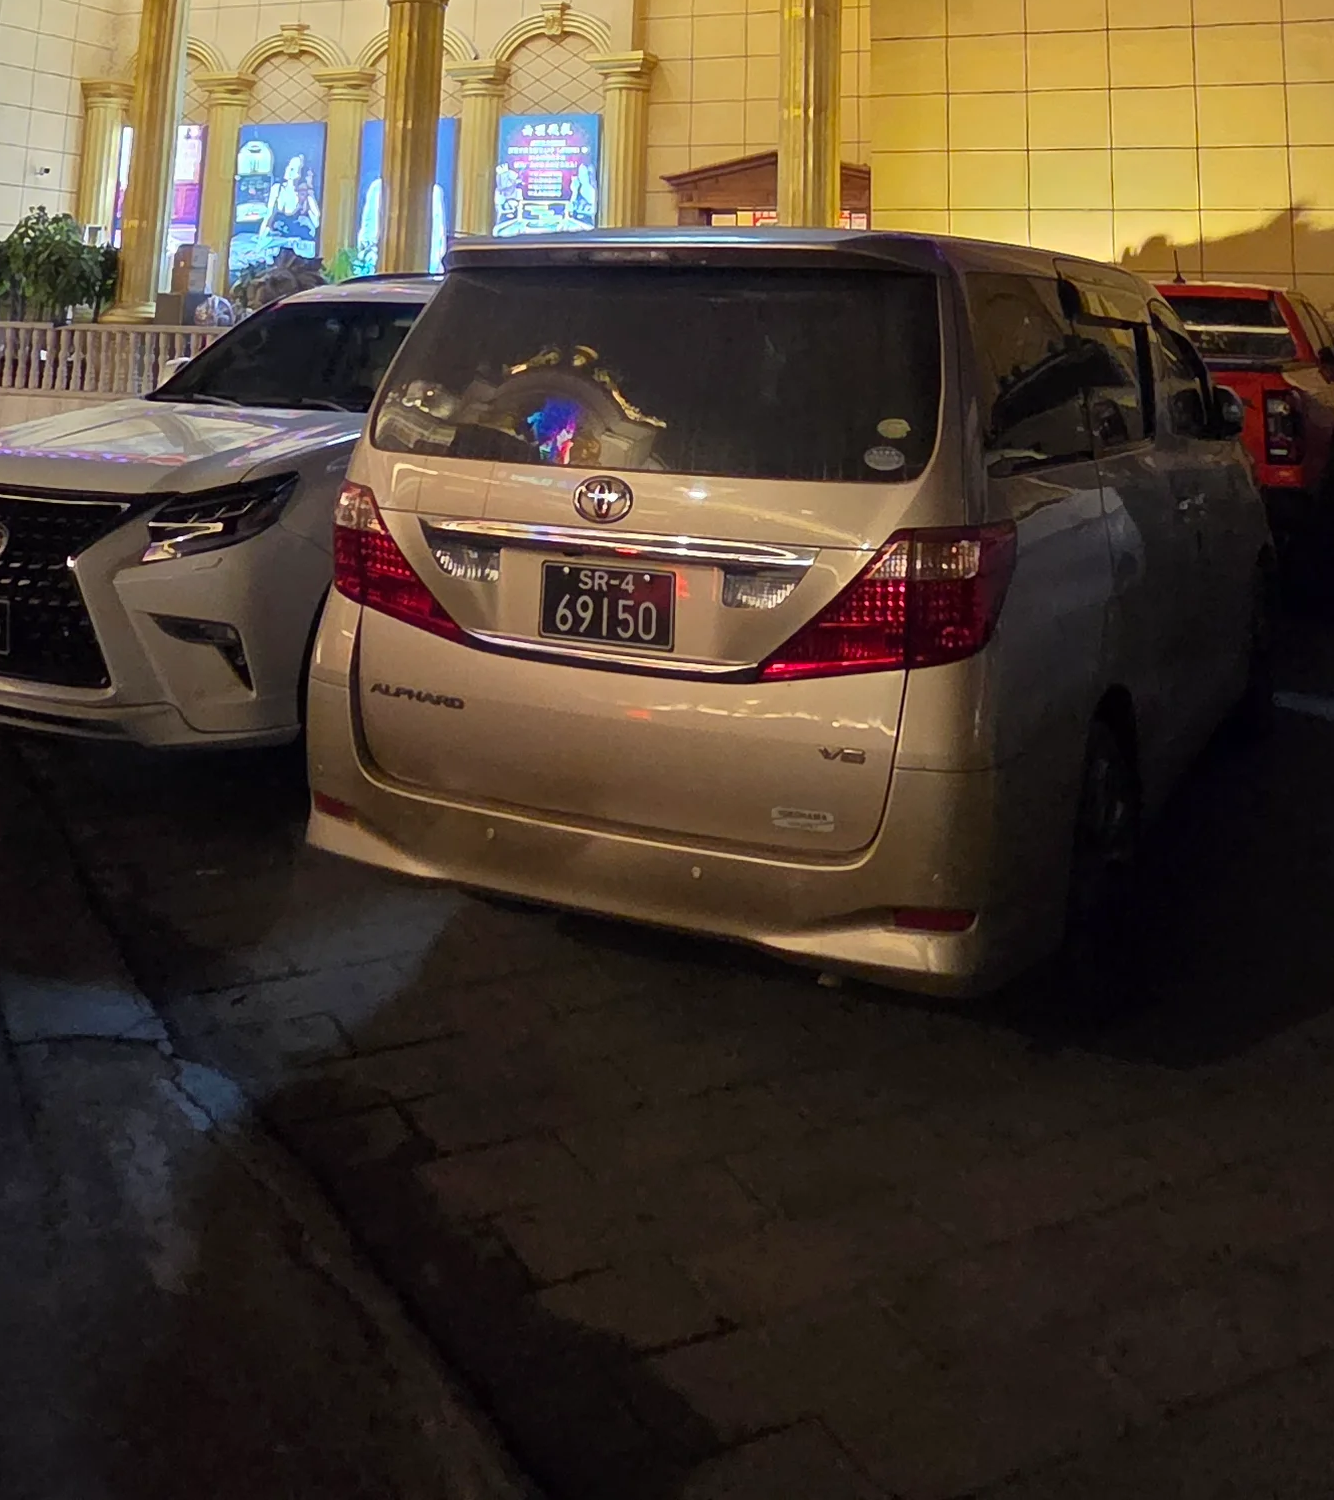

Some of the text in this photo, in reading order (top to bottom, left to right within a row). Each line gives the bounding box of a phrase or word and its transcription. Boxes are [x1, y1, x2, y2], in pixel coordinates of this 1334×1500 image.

[578, 570, 635, 594] SR-4
[555, 593, 657, 641] 69150
[370, 683, 464, 710] ALPHARD
